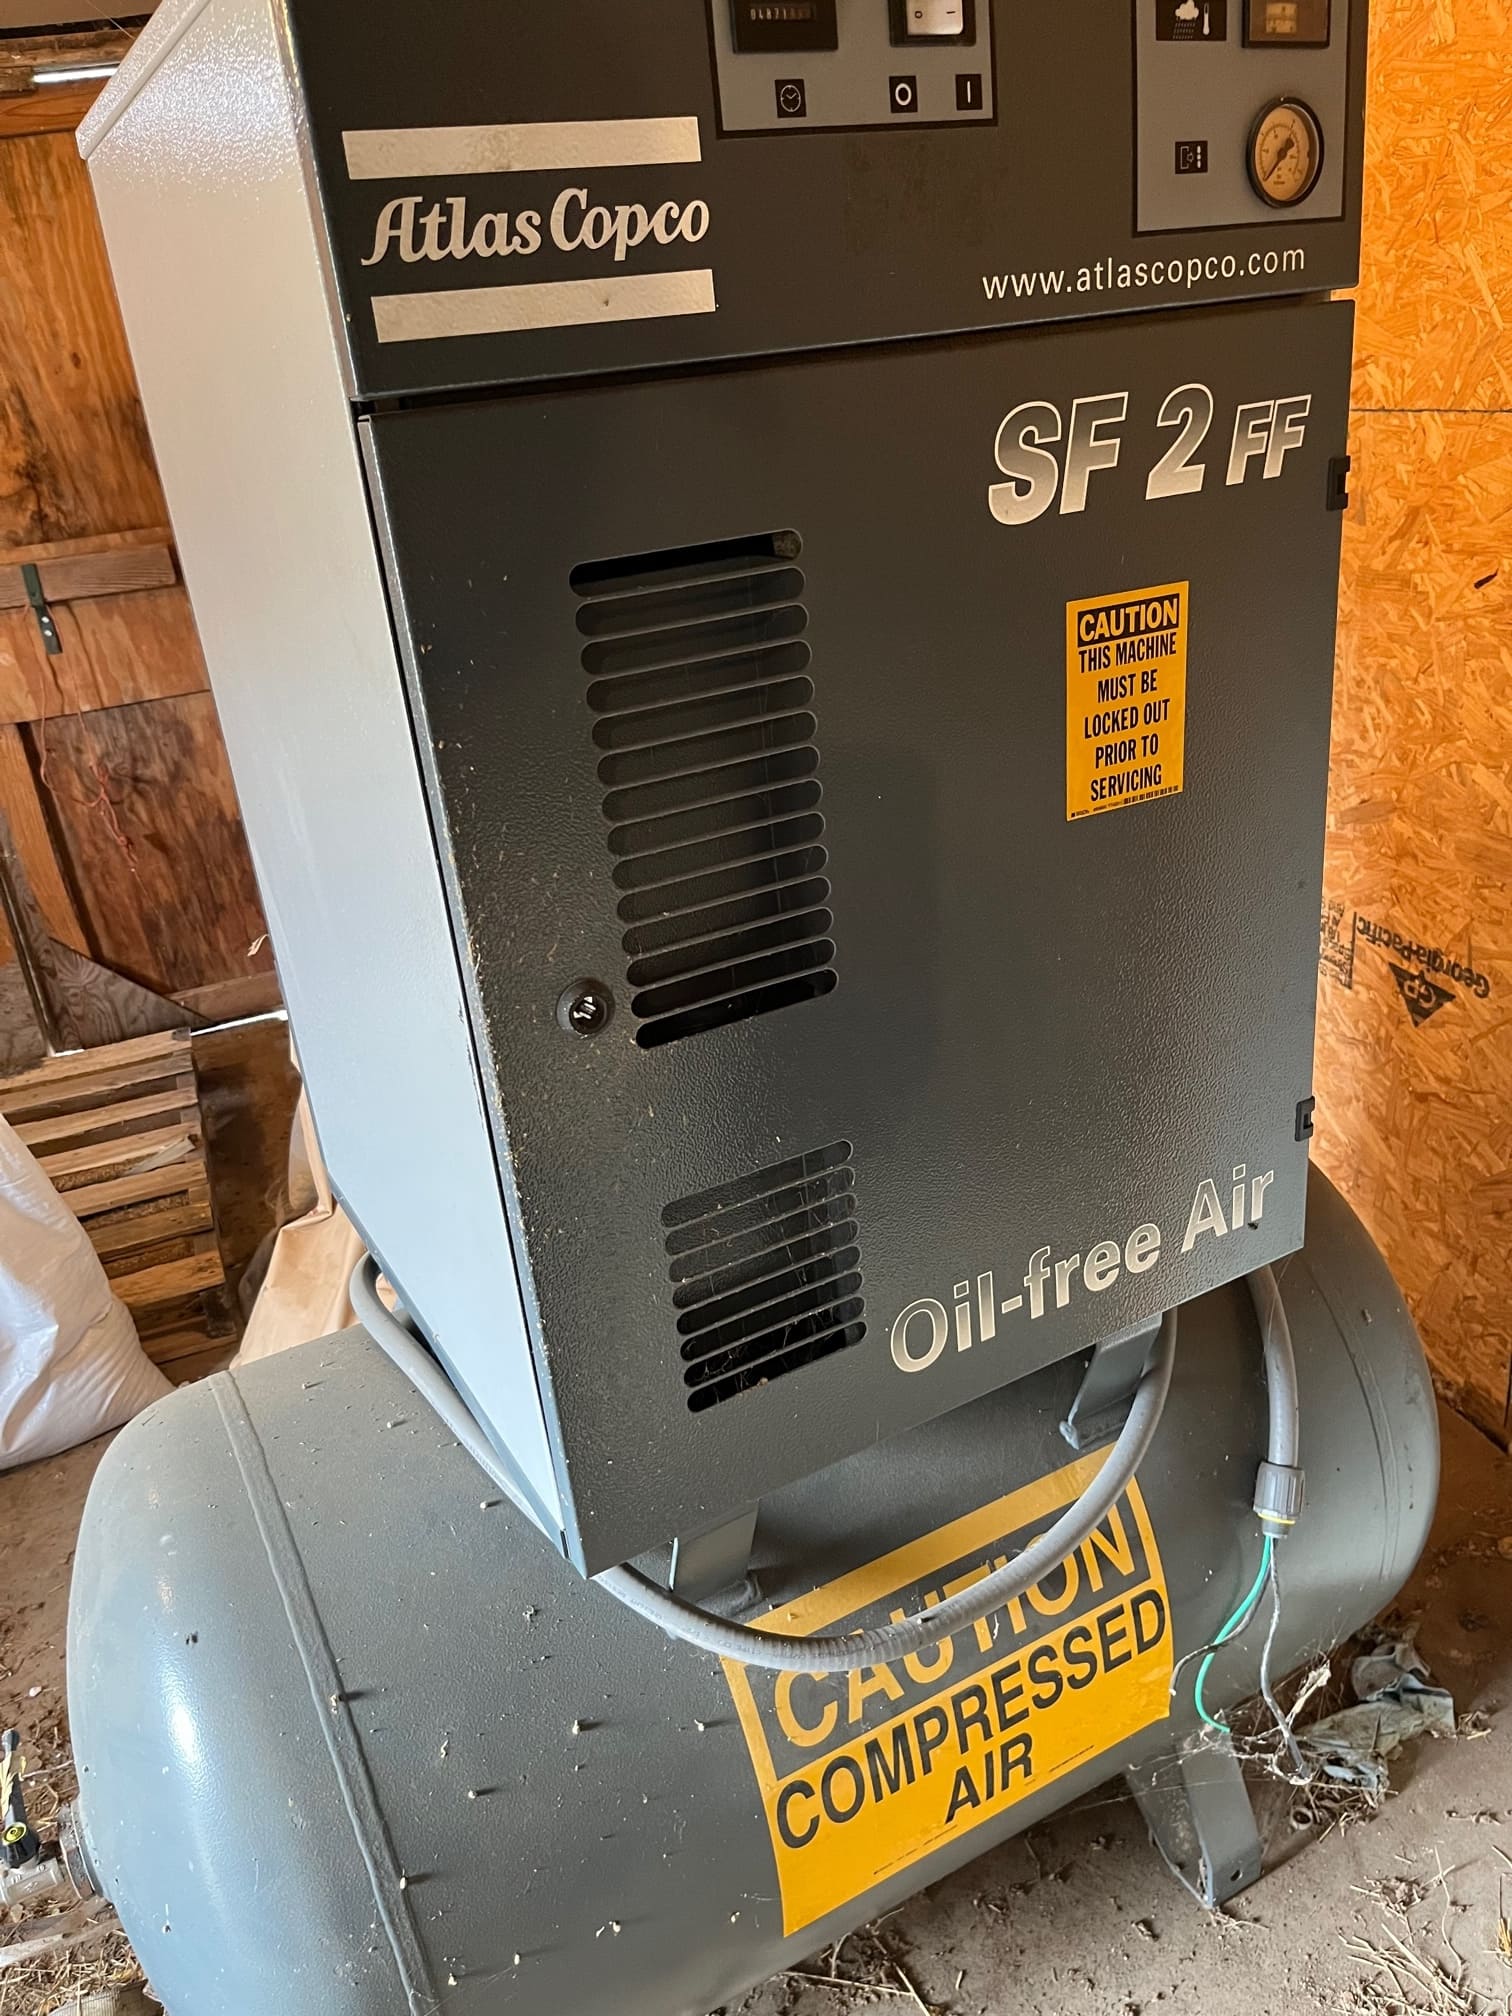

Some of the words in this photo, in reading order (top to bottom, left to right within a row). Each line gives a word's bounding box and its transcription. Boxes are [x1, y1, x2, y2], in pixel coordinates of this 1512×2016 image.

[361, 196, 542, 266] Atlas
[549, 187, 711, 261] Copco
[981, 246, 1306, 300] www.atlascopco.com
[988, 391, 1129, 525] SF
[1145, 383, 1214, 500] 2
[1225, 393, 1312, 486] FF
[1079, 598, 1178, 642] CAUTION
[1079, 645, 1111, 673] THIS
[1115, 632, 1177, 666] MACHINE
[1084, 706, 1139, 739] LOCKED
[1143, 699, 1170, 725] OUT
[1098, 674, 1137, 703] MUST
[1141, 669, 1158, 693] BE
[1090, 764, 1162, 802] SERVICING
[1095, 738, 1137, 769] PRIOR
[1141, 733, 1159, 757] TO
[1356, 915, 1491, 999] Georgia-Pacific
[890, 1223, 1160, 1373] Oil-free
[1181, 1163, 1275, 1253] Air
[774, 1503, 1136, 1747] CAUTION
[776, 1589, 1165, 1849] COMPRESSED
[944, 1732, 1033, 1825] AIR
